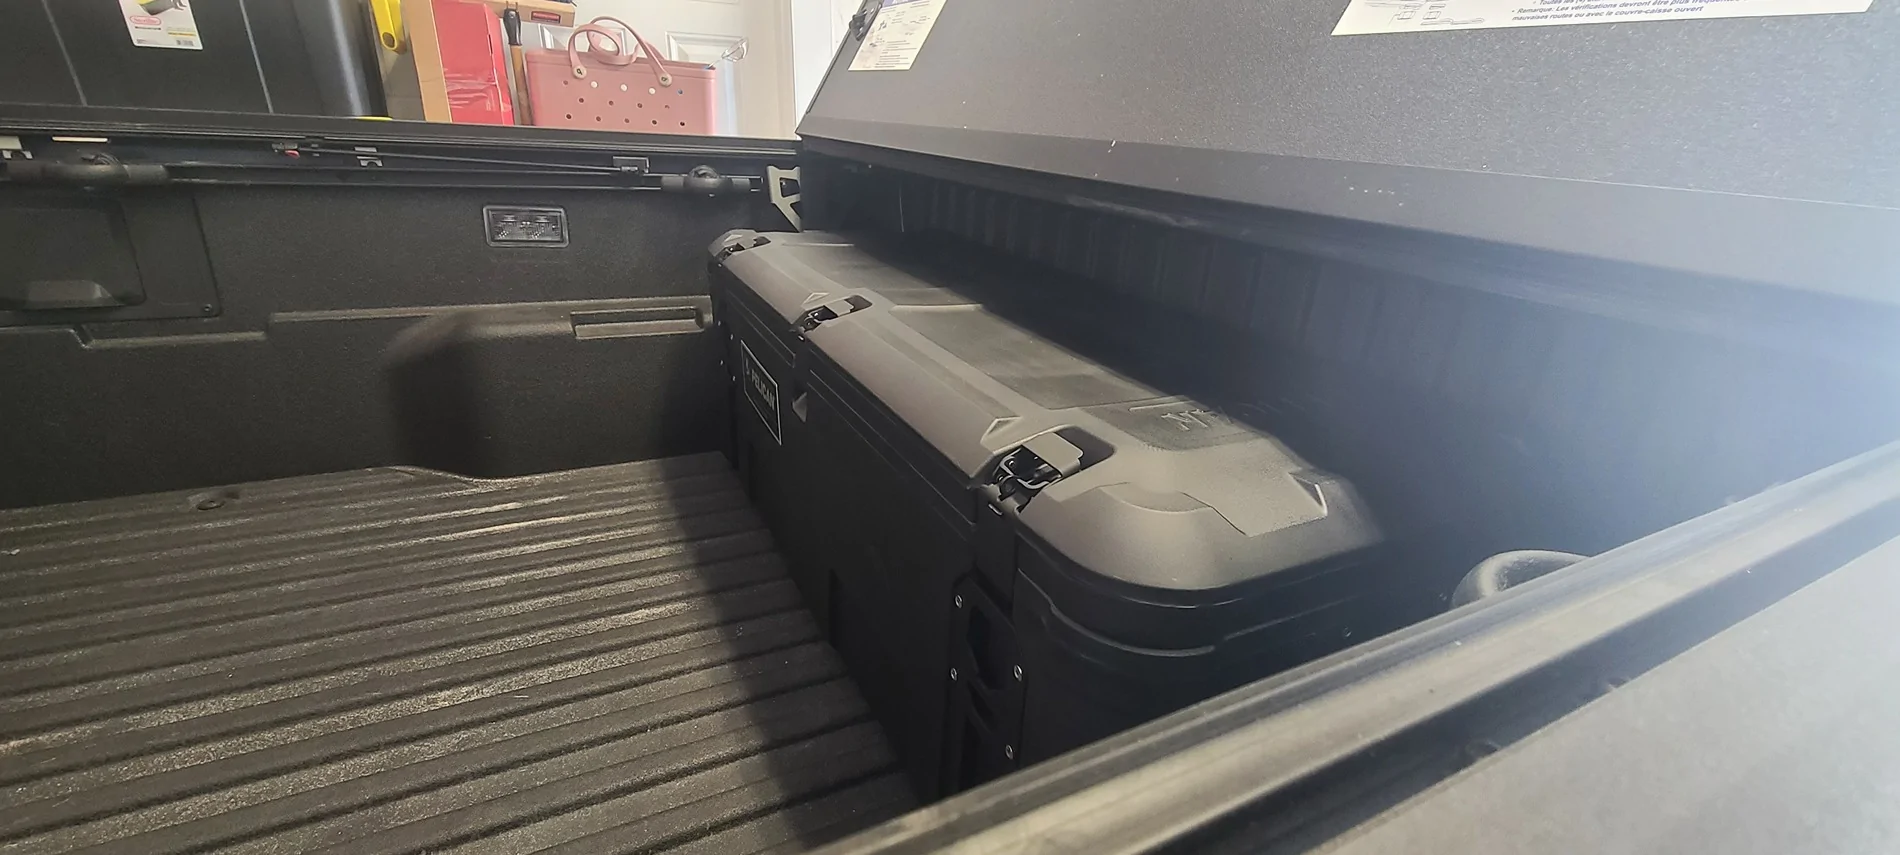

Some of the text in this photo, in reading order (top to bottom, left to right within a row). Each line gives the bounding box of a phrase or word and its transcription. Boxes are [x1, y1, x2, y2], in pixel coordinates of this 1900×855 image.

[1571, 3, 1617, 11] vérifications
[1615, 8, 1673, 16] couvre-caisse
[750, 368, 775, 411] PELICAN
